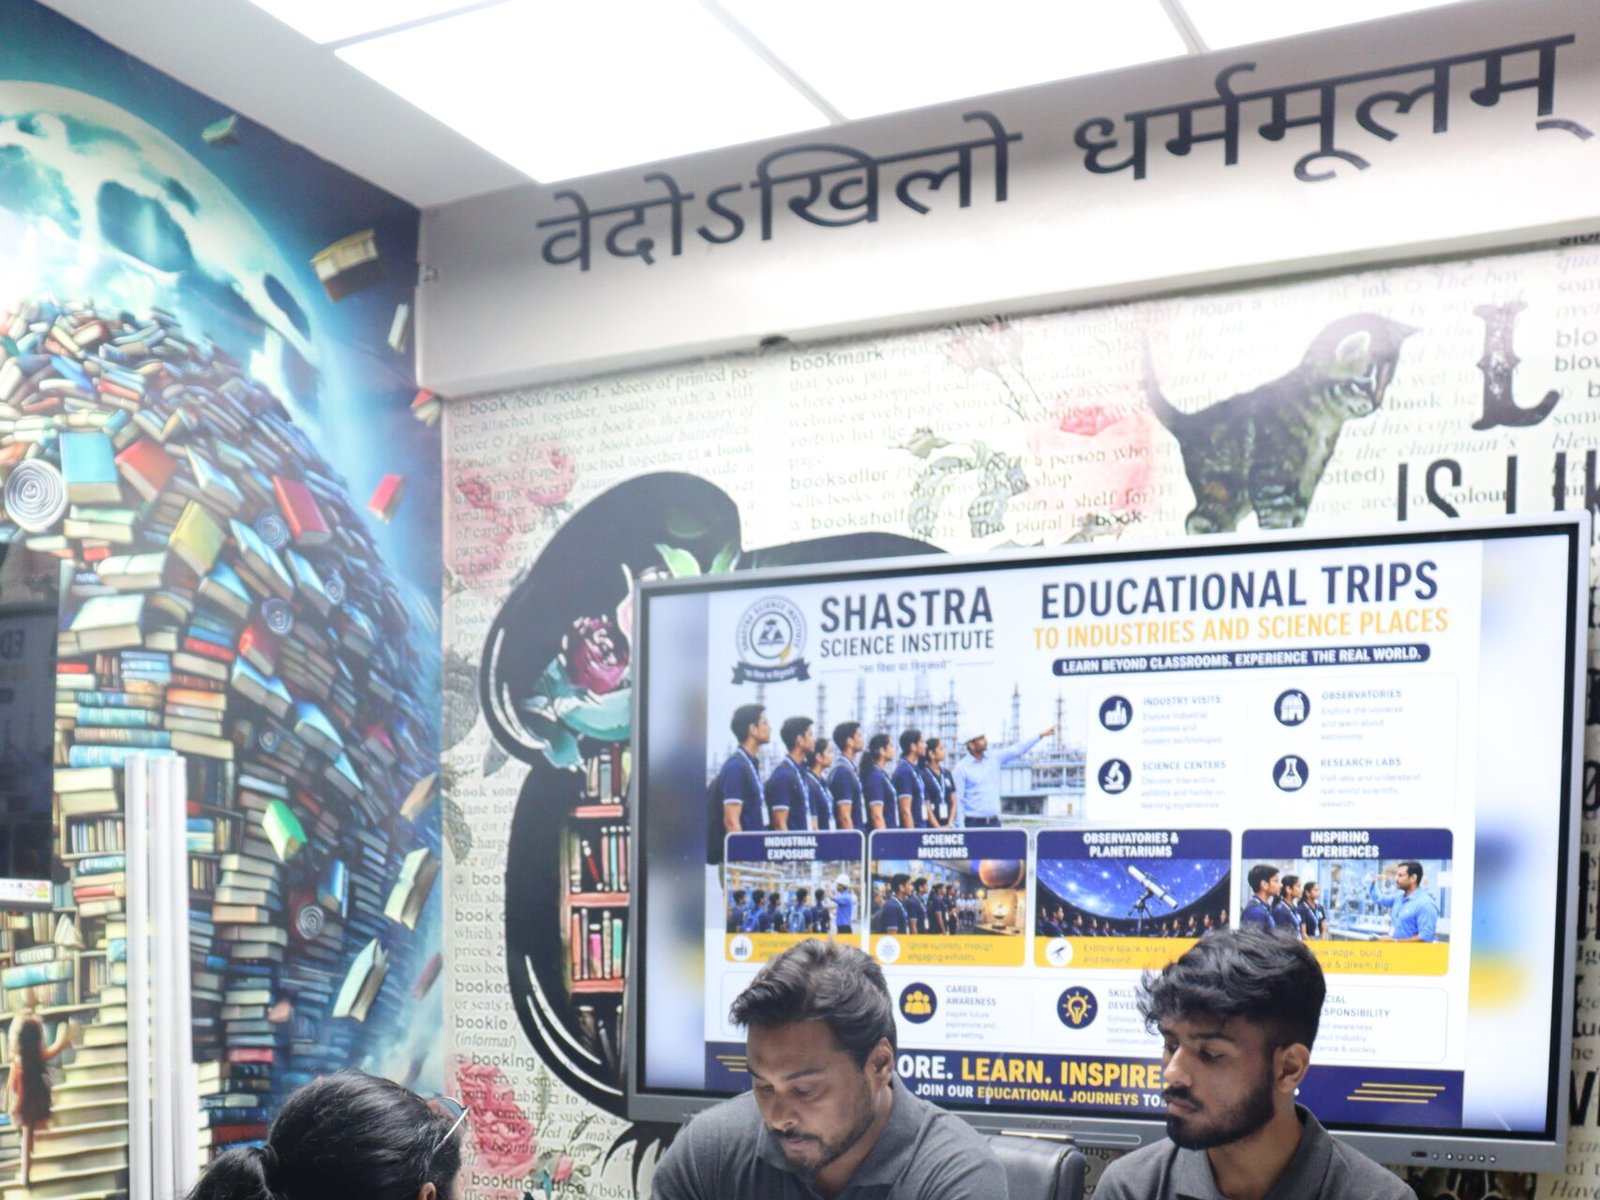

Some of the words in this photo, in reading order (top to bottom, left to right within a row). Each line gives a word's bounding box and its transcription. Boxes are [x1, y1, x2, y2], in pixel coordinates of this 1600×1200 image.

[536, 112, 1022, 273] वेदोऽखिलो
[1073, 34, 1595, 182] धर्ममूलम्
[788, 348, 886, 374] bookmark
[469, 398, 510, 416] book
[551, 387, 588, 406] noun
[611, 379, 651, 396] sheets
[656, 373, 674, 391] of
[676, 367, 726, 392] printed
[789, 390, 837, 410] where
[840, 387, 868, 404] you
[872, 380, 933, 403] stopped
[1389, 391, 1443, 411] book
[480, 412, 535, 432] attached
[608, 396, 657, 415] usually
[668, 389, 700, 407] with
[789, 410, 846, 429] website
[870, 401, 902, 418] web
[454, 438, 489, 453] cover
[1355, 440, 1387, 460] the
[1050, 450, 1106, 469] person
[1113, 442, 1150, 460] who
[788, 467, 889, 491] bookseller
[1074, 489, 1118, 507] shelf
[1040, 572, 1308, 620] EDUCATIONAL
[1320, 560, 1439, 605] TRIPS
[819, 584, 994, 635] SHASTRA
[1033, 623, 1060, 651] TO
[1065, 617, 1197, 650] INDUSTRIES
[1202, 614, 1250, 643] AND
[1257, 610, 1352, 642] SCIENCE
[1358, 606, 1450, 638] PLACES
[819, 634, 896, 659] SCIENCE
[901, 628, 995, 654] INSTITUTE
[1062, 658, 1099, 675] LEARN
[1101, 656, 1147, 673] BEYOND
[1235, 650, 1309, 668] EXPERIENCE
[1311, 648, 1338, 665] THE
[1338, 647, 1371, 664] REAL
[1372, 645, 1423, 663] WORLD.
[1143, 697, 1188, 706] INDUSTRY
[1191, 695, 1222, 705] VISITS
[1321, 689, 1403, 700] OBSERVATORIES
[1141, 761, 1181, 771] SCIENCE
[1184, 759, 1227, 770] CENTERS
[1320, 757, 1373, 768] RESEARCH
[1375, 756, 1402, 767] LABS
[764, 836, 818, 848] INDUSTRIAL
[922, 834, 965, 846] SCIENCE
[1083, 832, 1168, 845] OBSERVATORIES
[1169, 832, 1179, 843] &
[1310, 831, 1370, 844] INSPIRING
[767, 848, 816, 860] EXPOSURE
[918, 846, 968, 859] MUSEUMS
[1089, 845, 1173, 858] PLANETARIUMS
[1302, 844, 1380, 859] EXPERIENCES
[455, 908, 494, 923] book
[945, 984, 979, 995] CAREER
[945, 996, 997, 1008] AWARENESS
[455, 1014, 508, 1030] bookie
[455, 1032, 517, 1049] (informal)
[472, 1051, 535, 1072] booking
[896, 1053, 954, 1079] ORE.
[961, 1057, 1052, 1085] LEARN.
[914, 1082, 945, 1098] JOIN
[947, 1084, 974, 1098] OUR
[976, 1085, 1066, 1104] EDUCATIONAL
[1070, 1090, 1139, 1107] JOURNEYS
[1142, 1093, 1161, 1108] TO
[471, 1171, 534, 1190] booking
